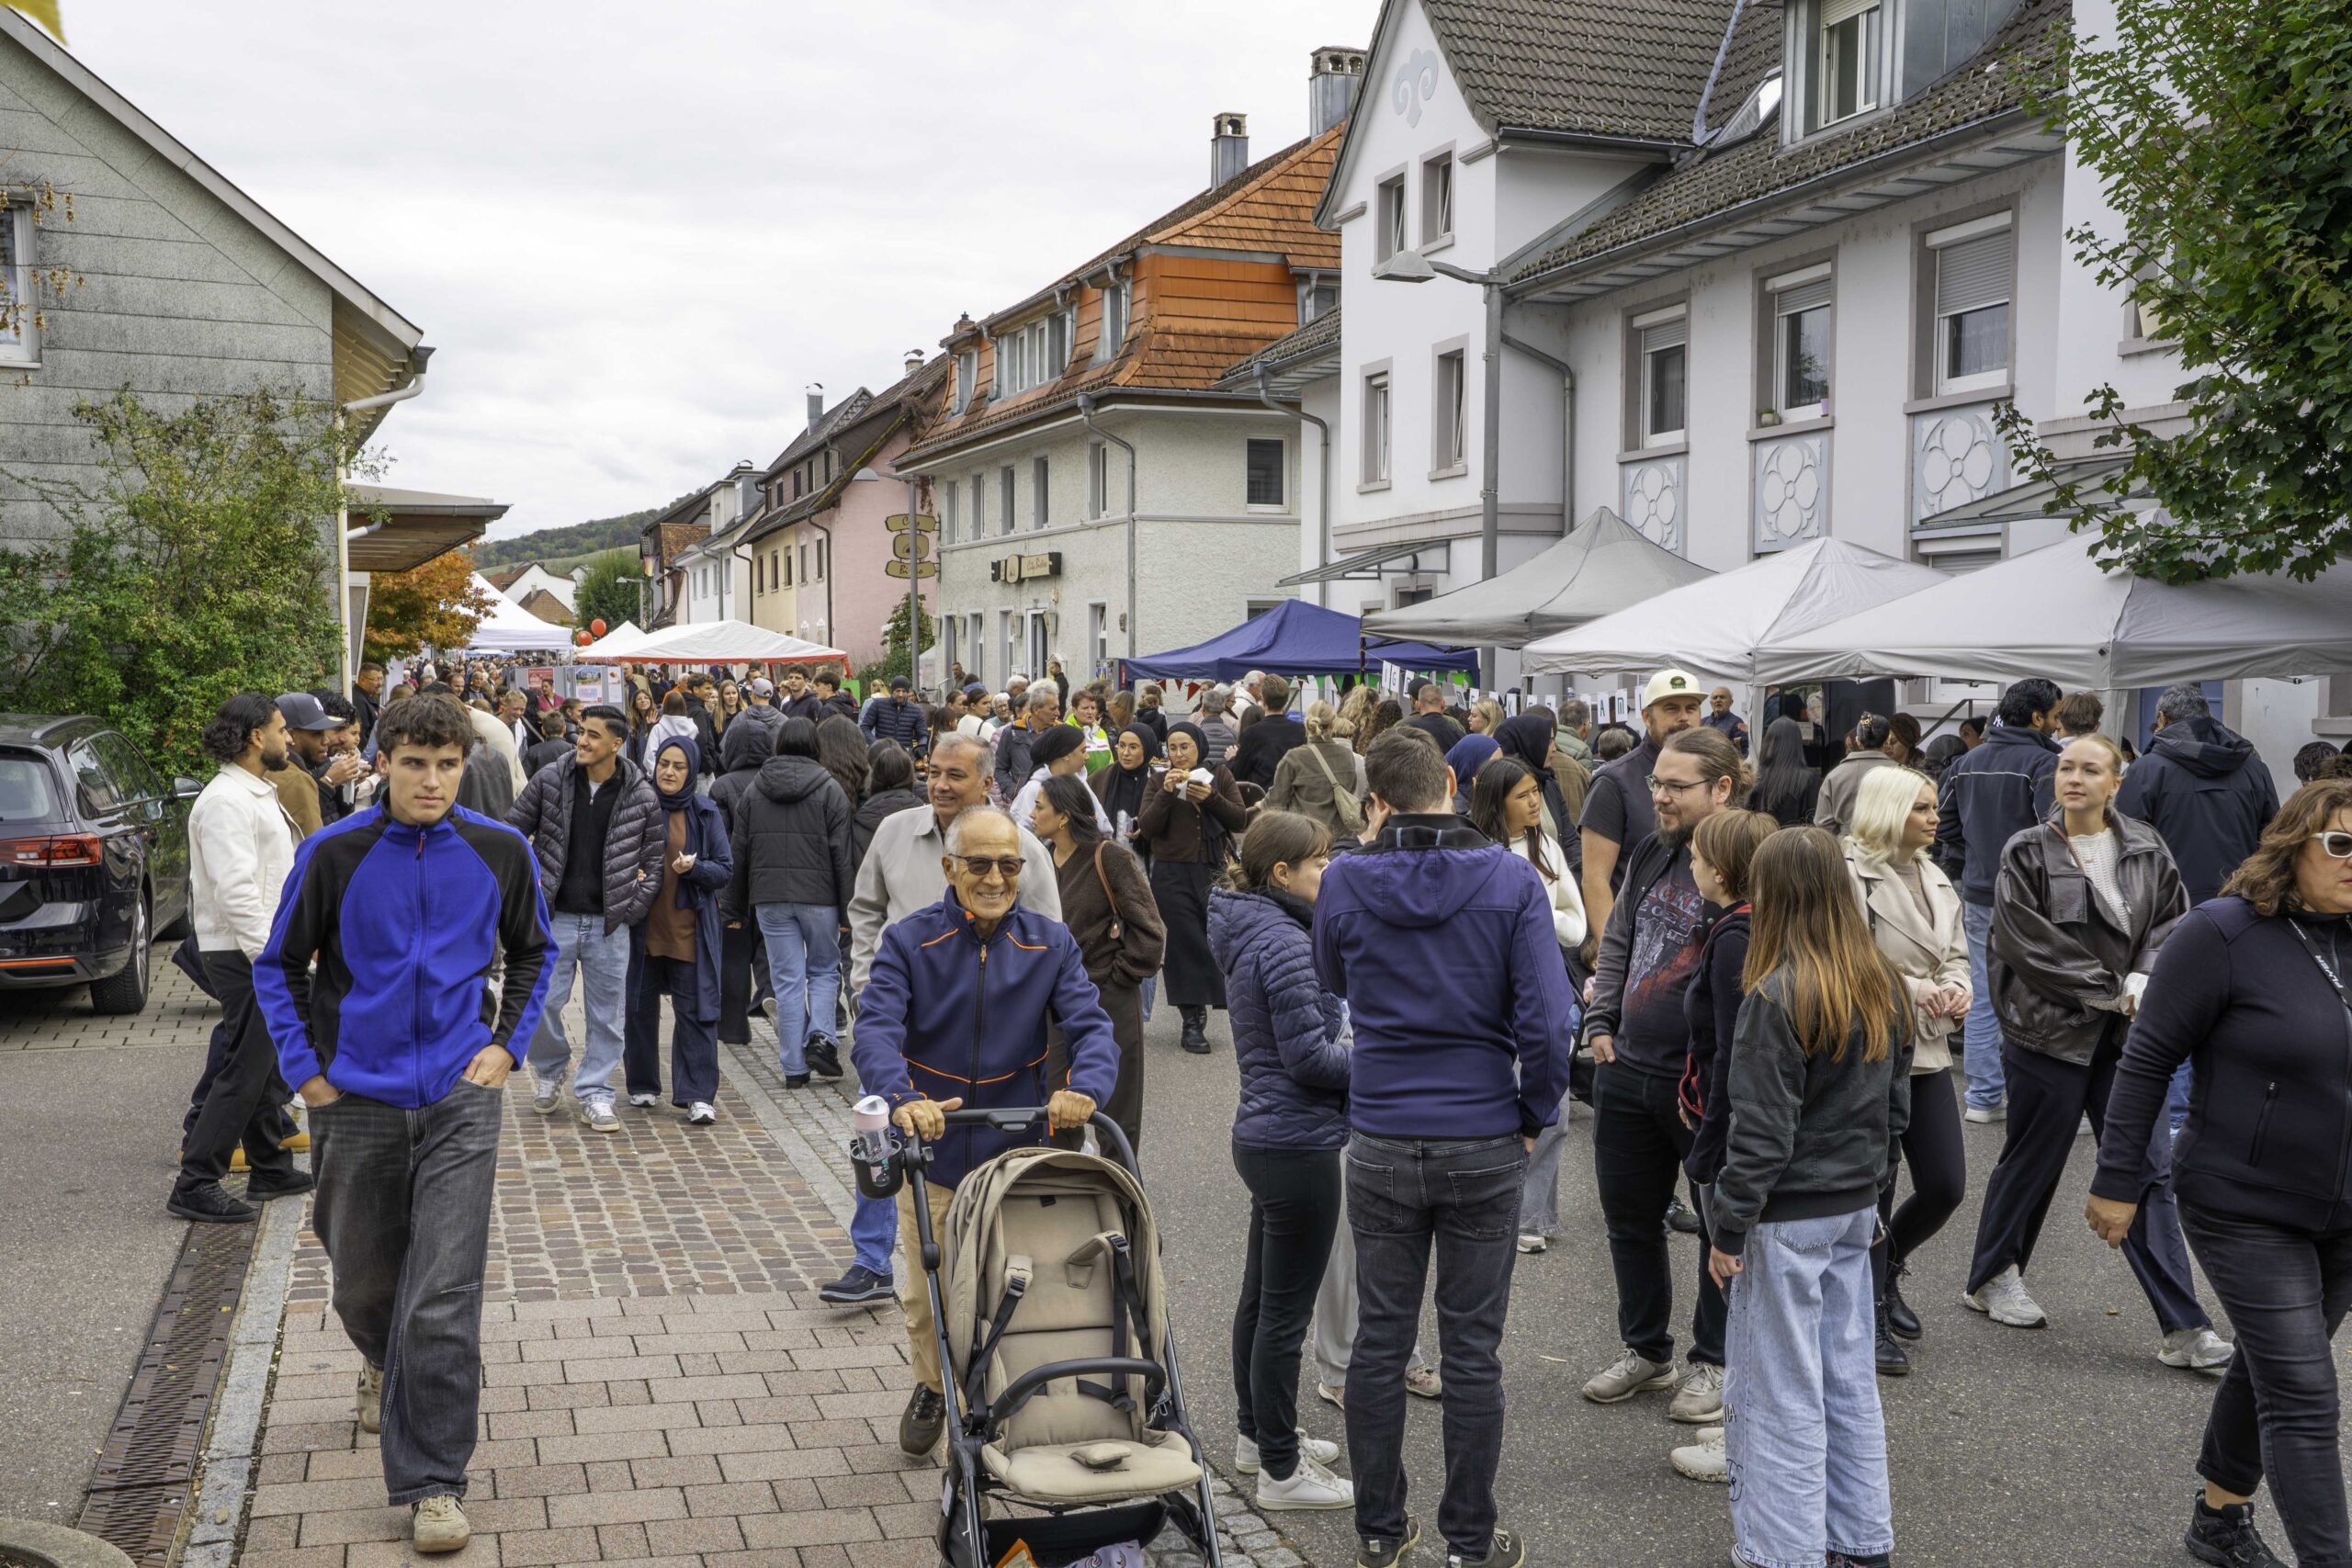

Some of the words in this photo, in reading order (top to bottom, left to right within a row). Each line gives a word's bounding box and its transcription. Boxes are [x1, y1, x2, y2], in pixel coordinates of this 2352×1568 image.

[902, 515, 921, 528] Cy
[899, 564, 923, 575] Bio
[2315, 955, 2345, 987] FLYER
